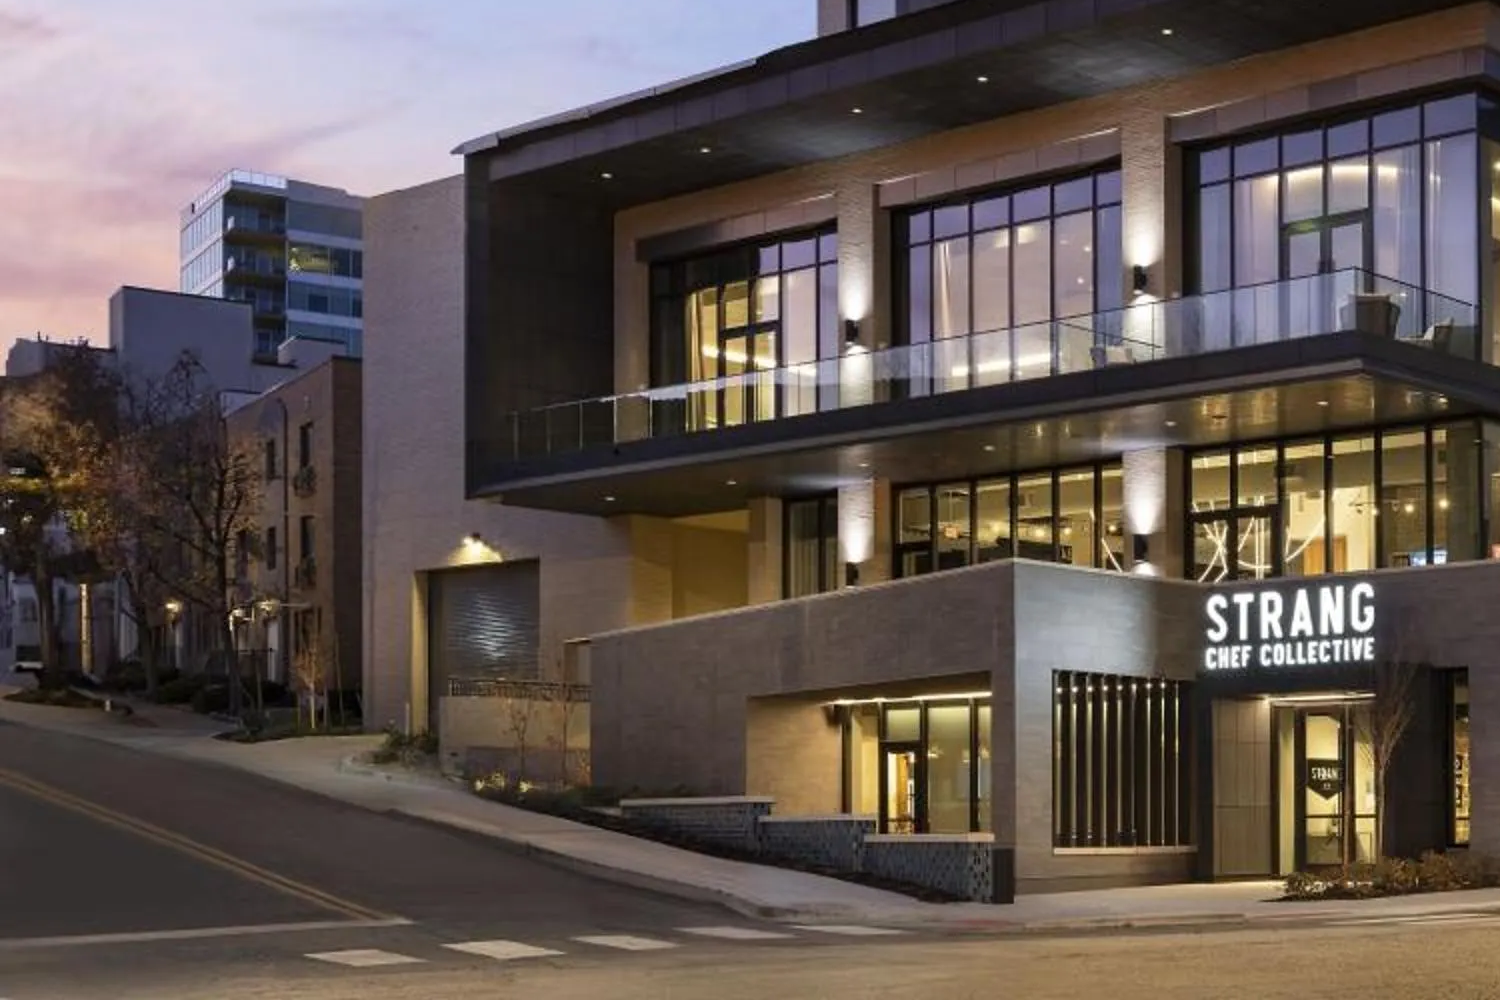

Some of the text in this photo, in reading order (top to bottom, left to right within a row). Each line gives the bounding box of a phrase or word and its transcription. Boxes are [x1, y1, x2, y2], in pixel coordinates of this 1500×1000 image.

[1205, 582, 1376, 643] STRANG
[1205, 637, 1375, 671] CHEF COLLECTIVE
